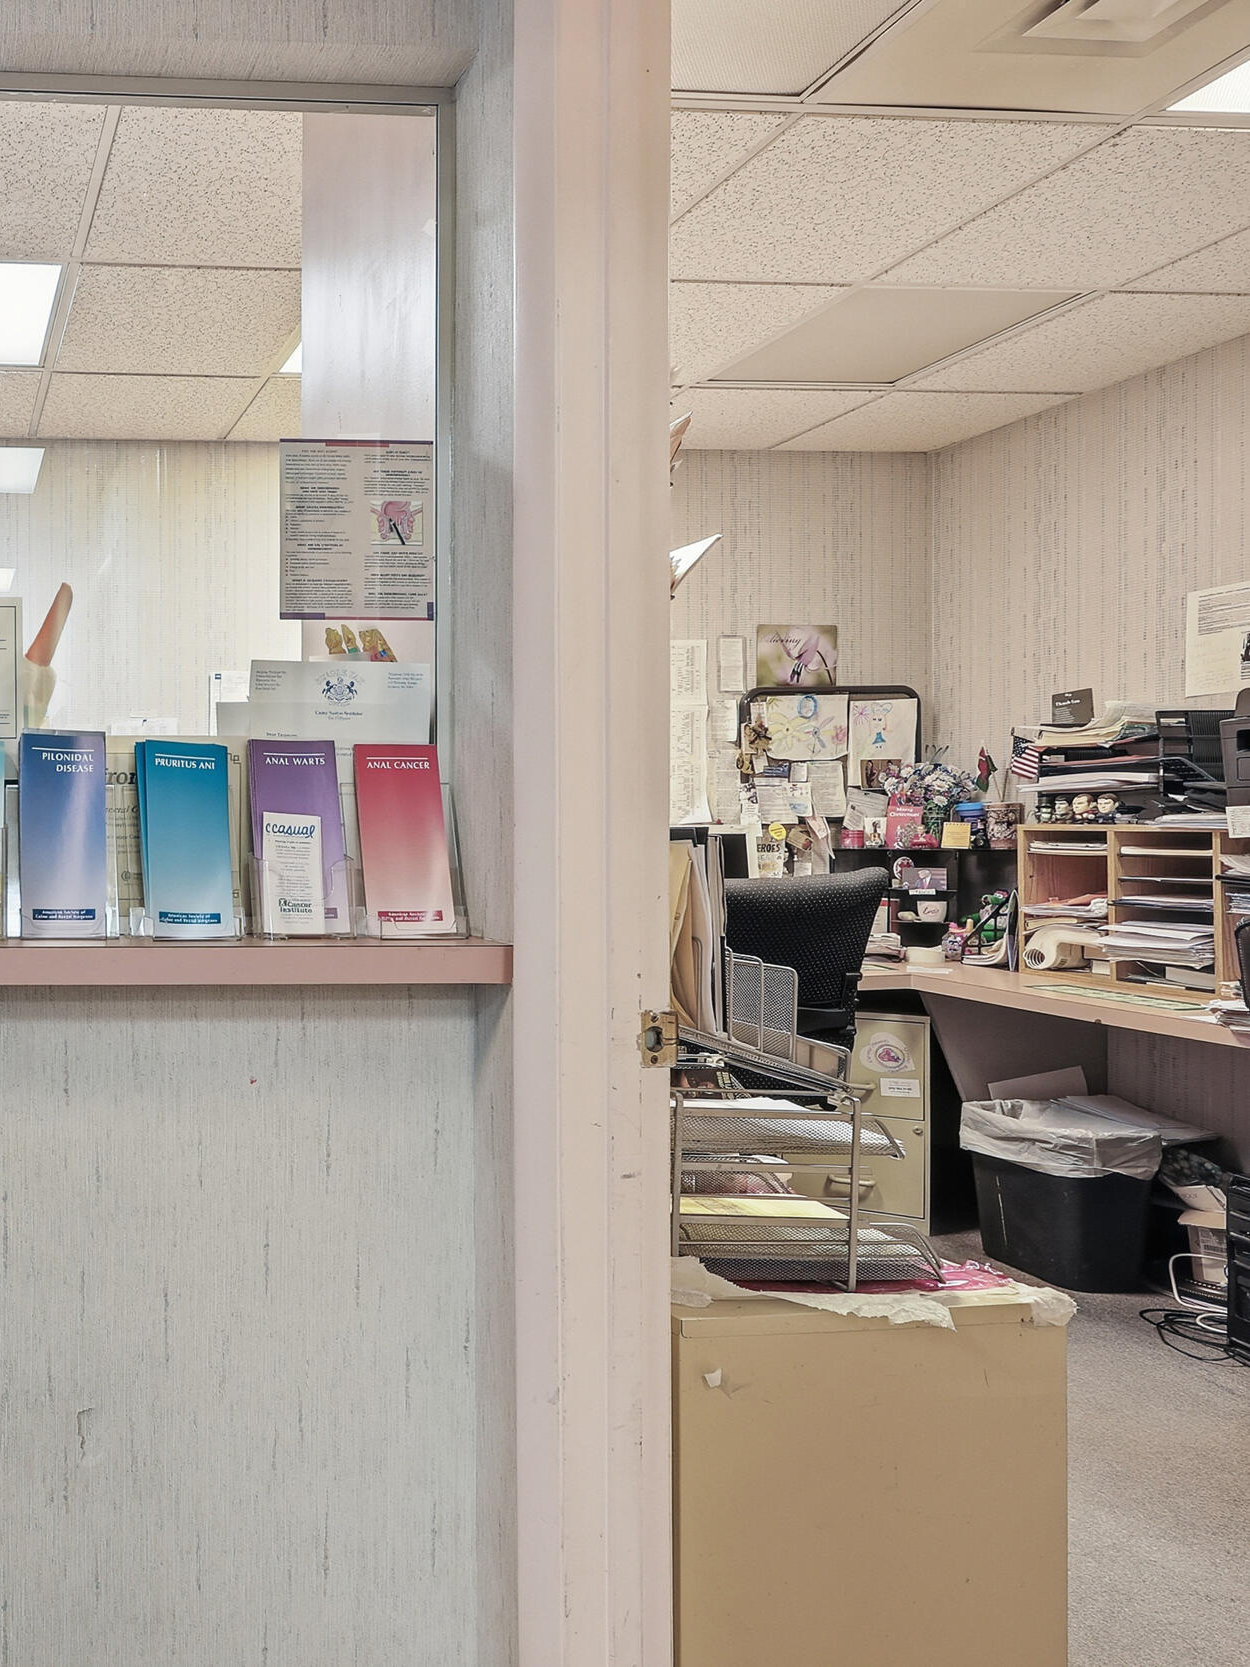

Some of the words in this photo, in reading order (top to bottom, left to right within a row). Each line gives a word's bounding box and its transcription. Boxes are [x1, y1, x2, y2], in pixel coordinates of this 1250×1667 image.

[42, 752, 94, 762] PILONIDAL
[265, 757, 290, 765] ANAL
[293, 757, 325, 766] WARTS
[56, 764, 94, 773] DISEASE
[155, 758, 197, 769] PRURITUS
[198, 761, 215, 770] ANI
[366, 761, 392, 769] ANAL
[394, 761, 430, 770] CANCER
[271, 823, 315, 839] casual
[757, 843, 781, 853] EROES
